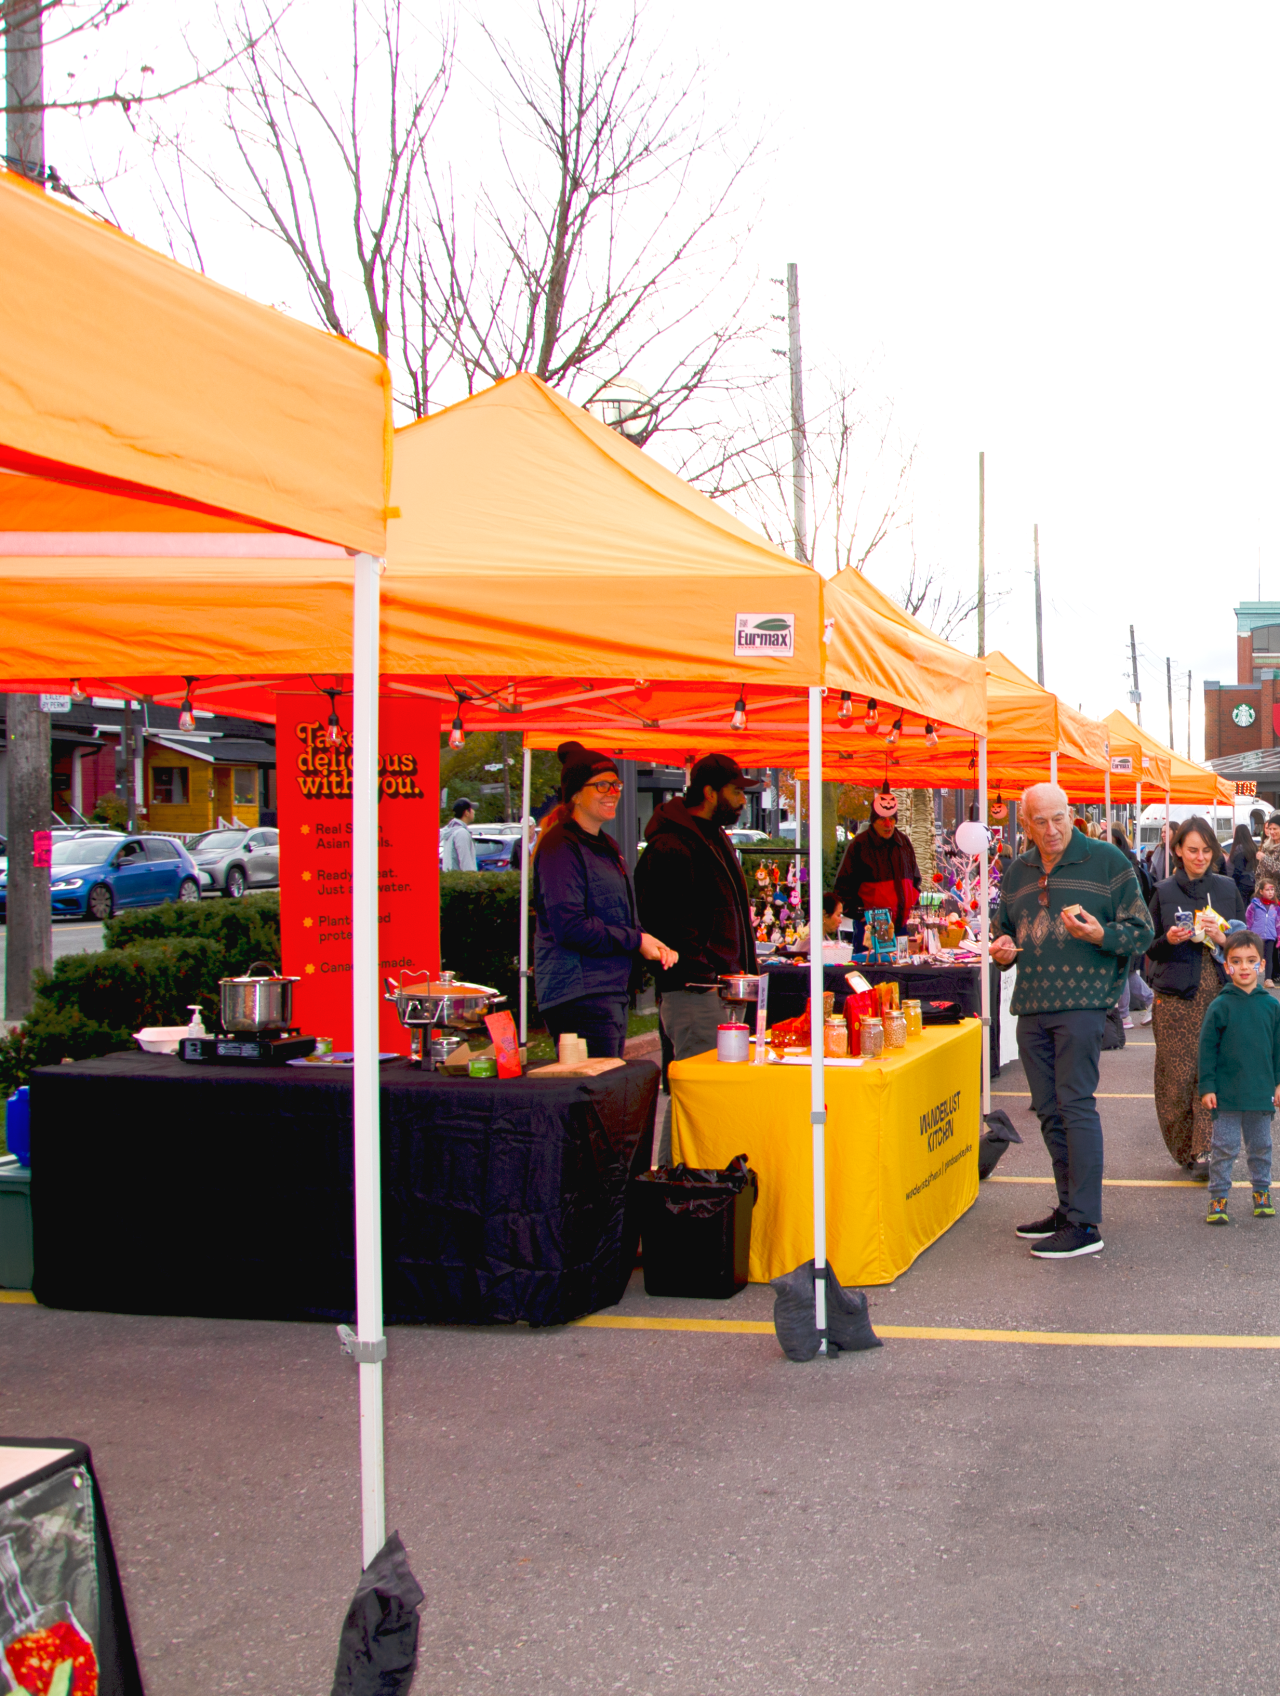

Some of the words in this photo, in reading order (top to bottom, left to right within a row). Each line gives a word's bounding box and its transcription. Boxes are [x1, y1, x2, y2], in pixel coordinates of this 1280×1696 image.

[738, 629, 788, 647] Eurmax
[42, 701, 49, 709] BY
[296, 767, 353, 798] with
[316, 823, 342, 835] Real
[316, 838, 350, 850] Asian
[317, 869, 353, 882] Ready
[317, 884, 345, 895] Just
[919, 1090, 961, 1136] WANDERLUST
[927, 1117, 954, 1153] KITCHEN
